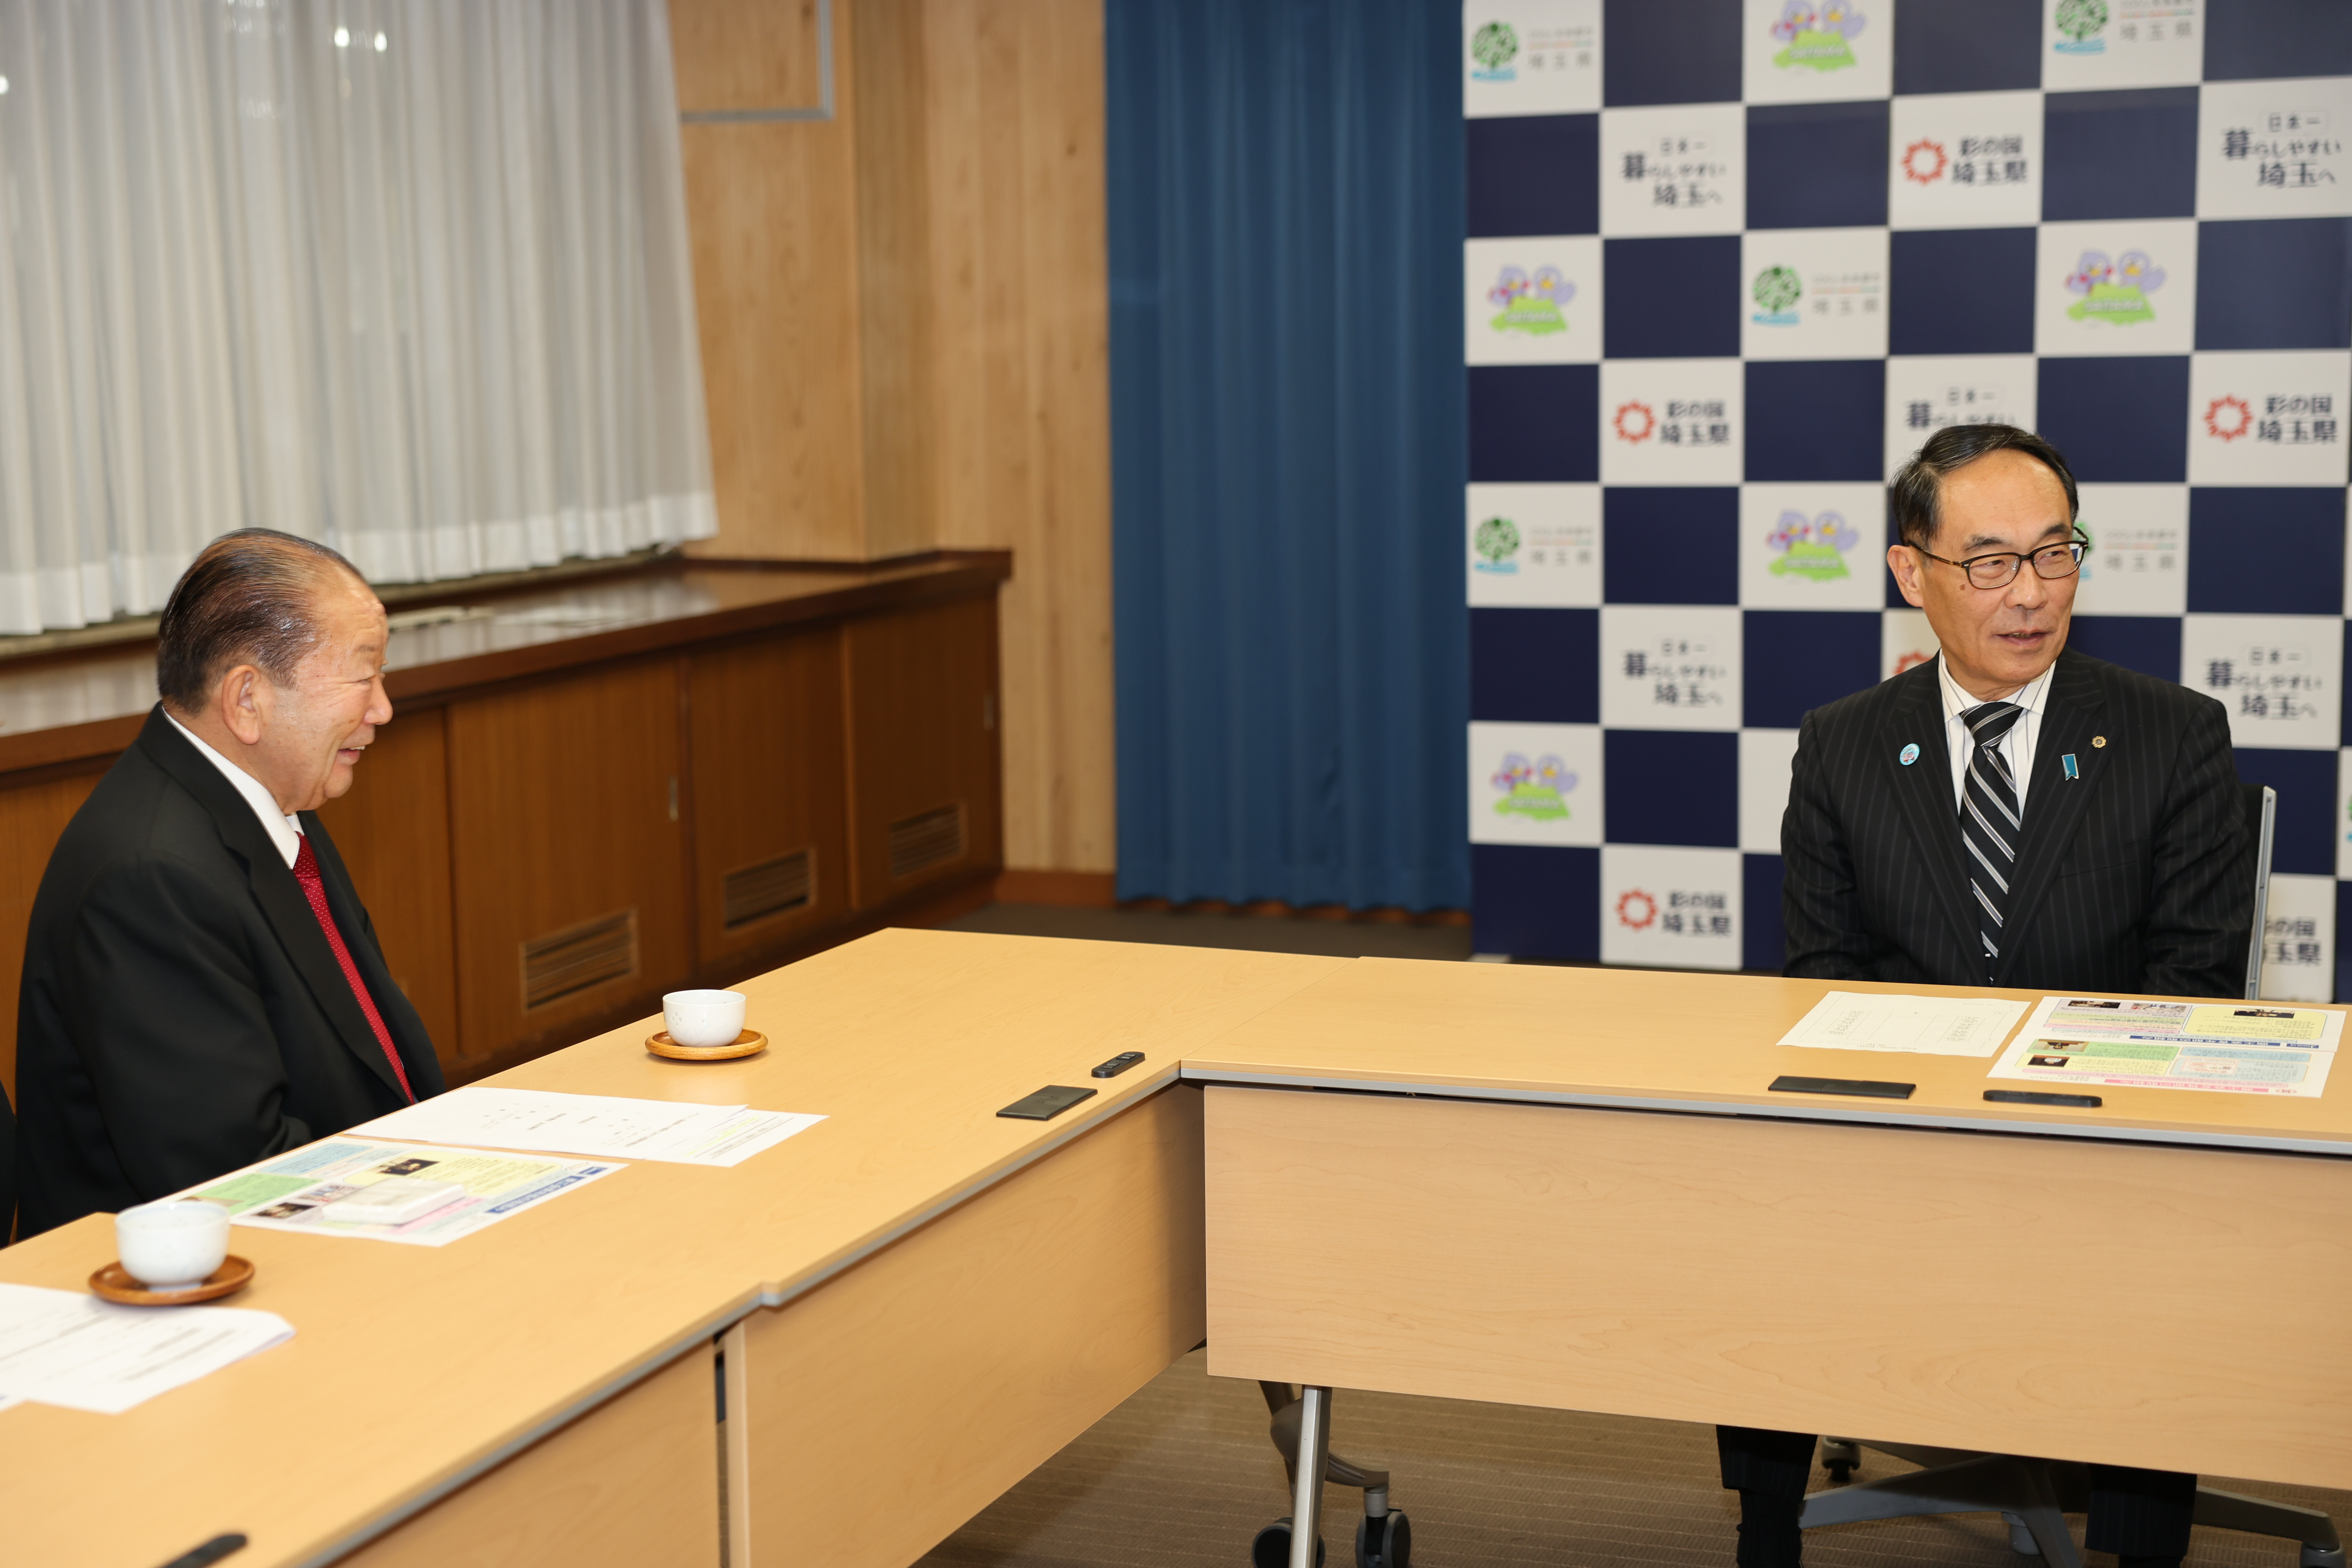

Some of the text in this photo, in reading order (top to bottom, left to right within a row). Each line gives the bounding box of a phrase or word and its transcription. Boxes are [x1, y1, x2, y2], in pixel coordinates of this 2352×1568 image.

[2267, 112, 2322, 132] 日本一
[1958, 135, 2024, 156] 彩の国
[2221, 126, 2341, 160] 暮らしやすい
[1952, 159, 2028, 186] 埼玉県
[2257, 160, 2336, 189] 埼玉へ
[1666, 400, 1725, 419] 彩の国
[2265, 395, 2332, 415] 彩の国
[1660, 421, 1730, 446] 埼玉県
[2257, 418, 2339, 445] 埼玉県
[2240, 692, 2318, 720] 埼玉へ
[1663, 913, 1732, 937] 埼玉県
[2265, 940, 2321, 966] 玉県
